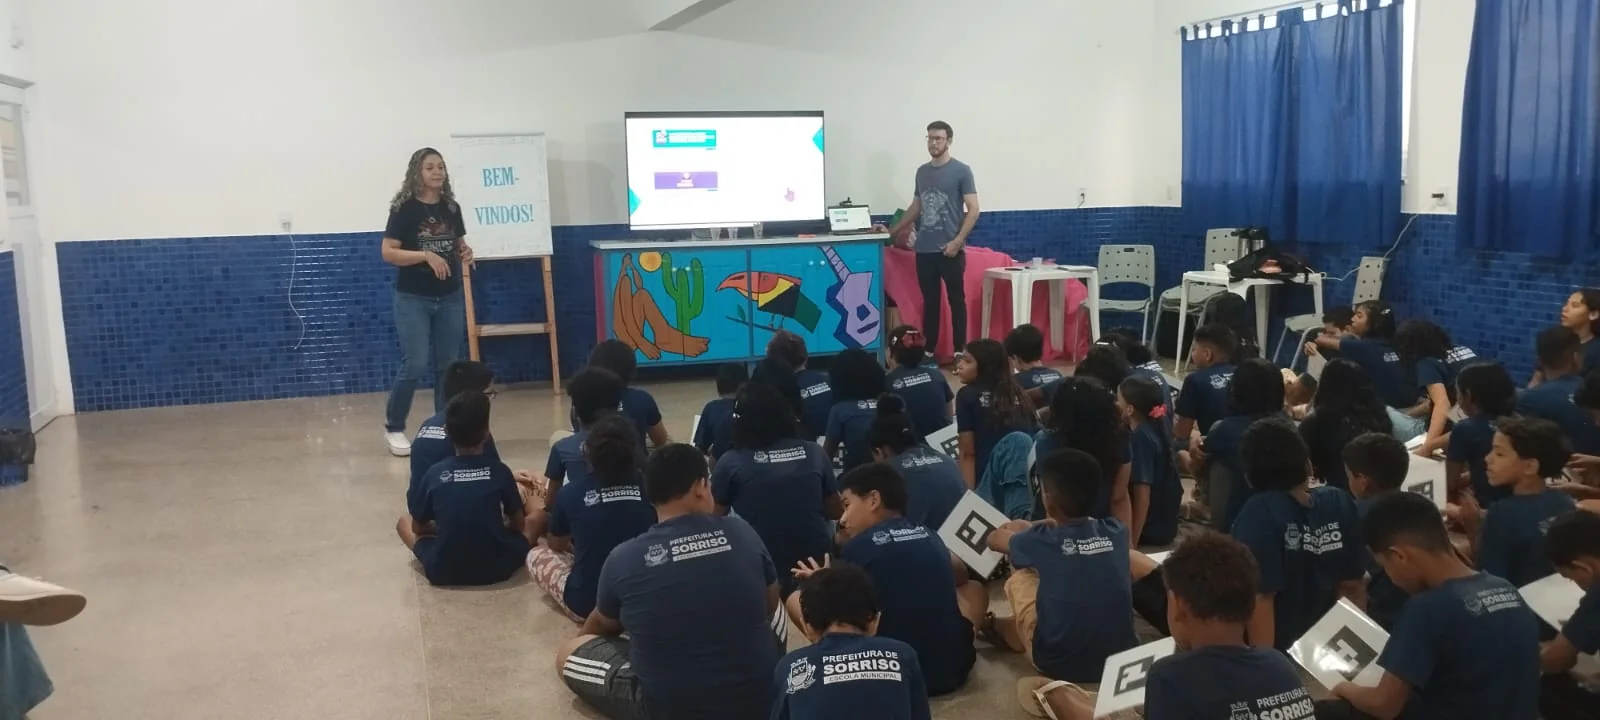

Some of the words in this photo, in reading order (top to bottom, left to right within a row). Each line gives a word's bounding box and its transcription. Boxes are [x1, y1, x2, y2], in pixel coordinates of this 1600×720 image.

[482, 166, 519, 187] BEM-
[475, 204, 534, 225] VINDOS!
[769, 450, 806, 458] SORRISO
[454, 470, 491, 479] SORRISO
[601, 490, 641, 498] SORRISO
[1327, 522, 1340, 530] DE
[669, 532, 714, 546] PREFEITURA
[671, 536, 728, 555] SORRISO
[822, 650, 884, 664] PREFEITURA
[885, 651, 898, 659] DE
[823, 659, 901, 675] SORRISO
[829, 674, 859, 682] ESCOLA
[860, 672, 898, 680] MUNICIPAL
[1256, 687, 1304, 709] PREFEITURA
